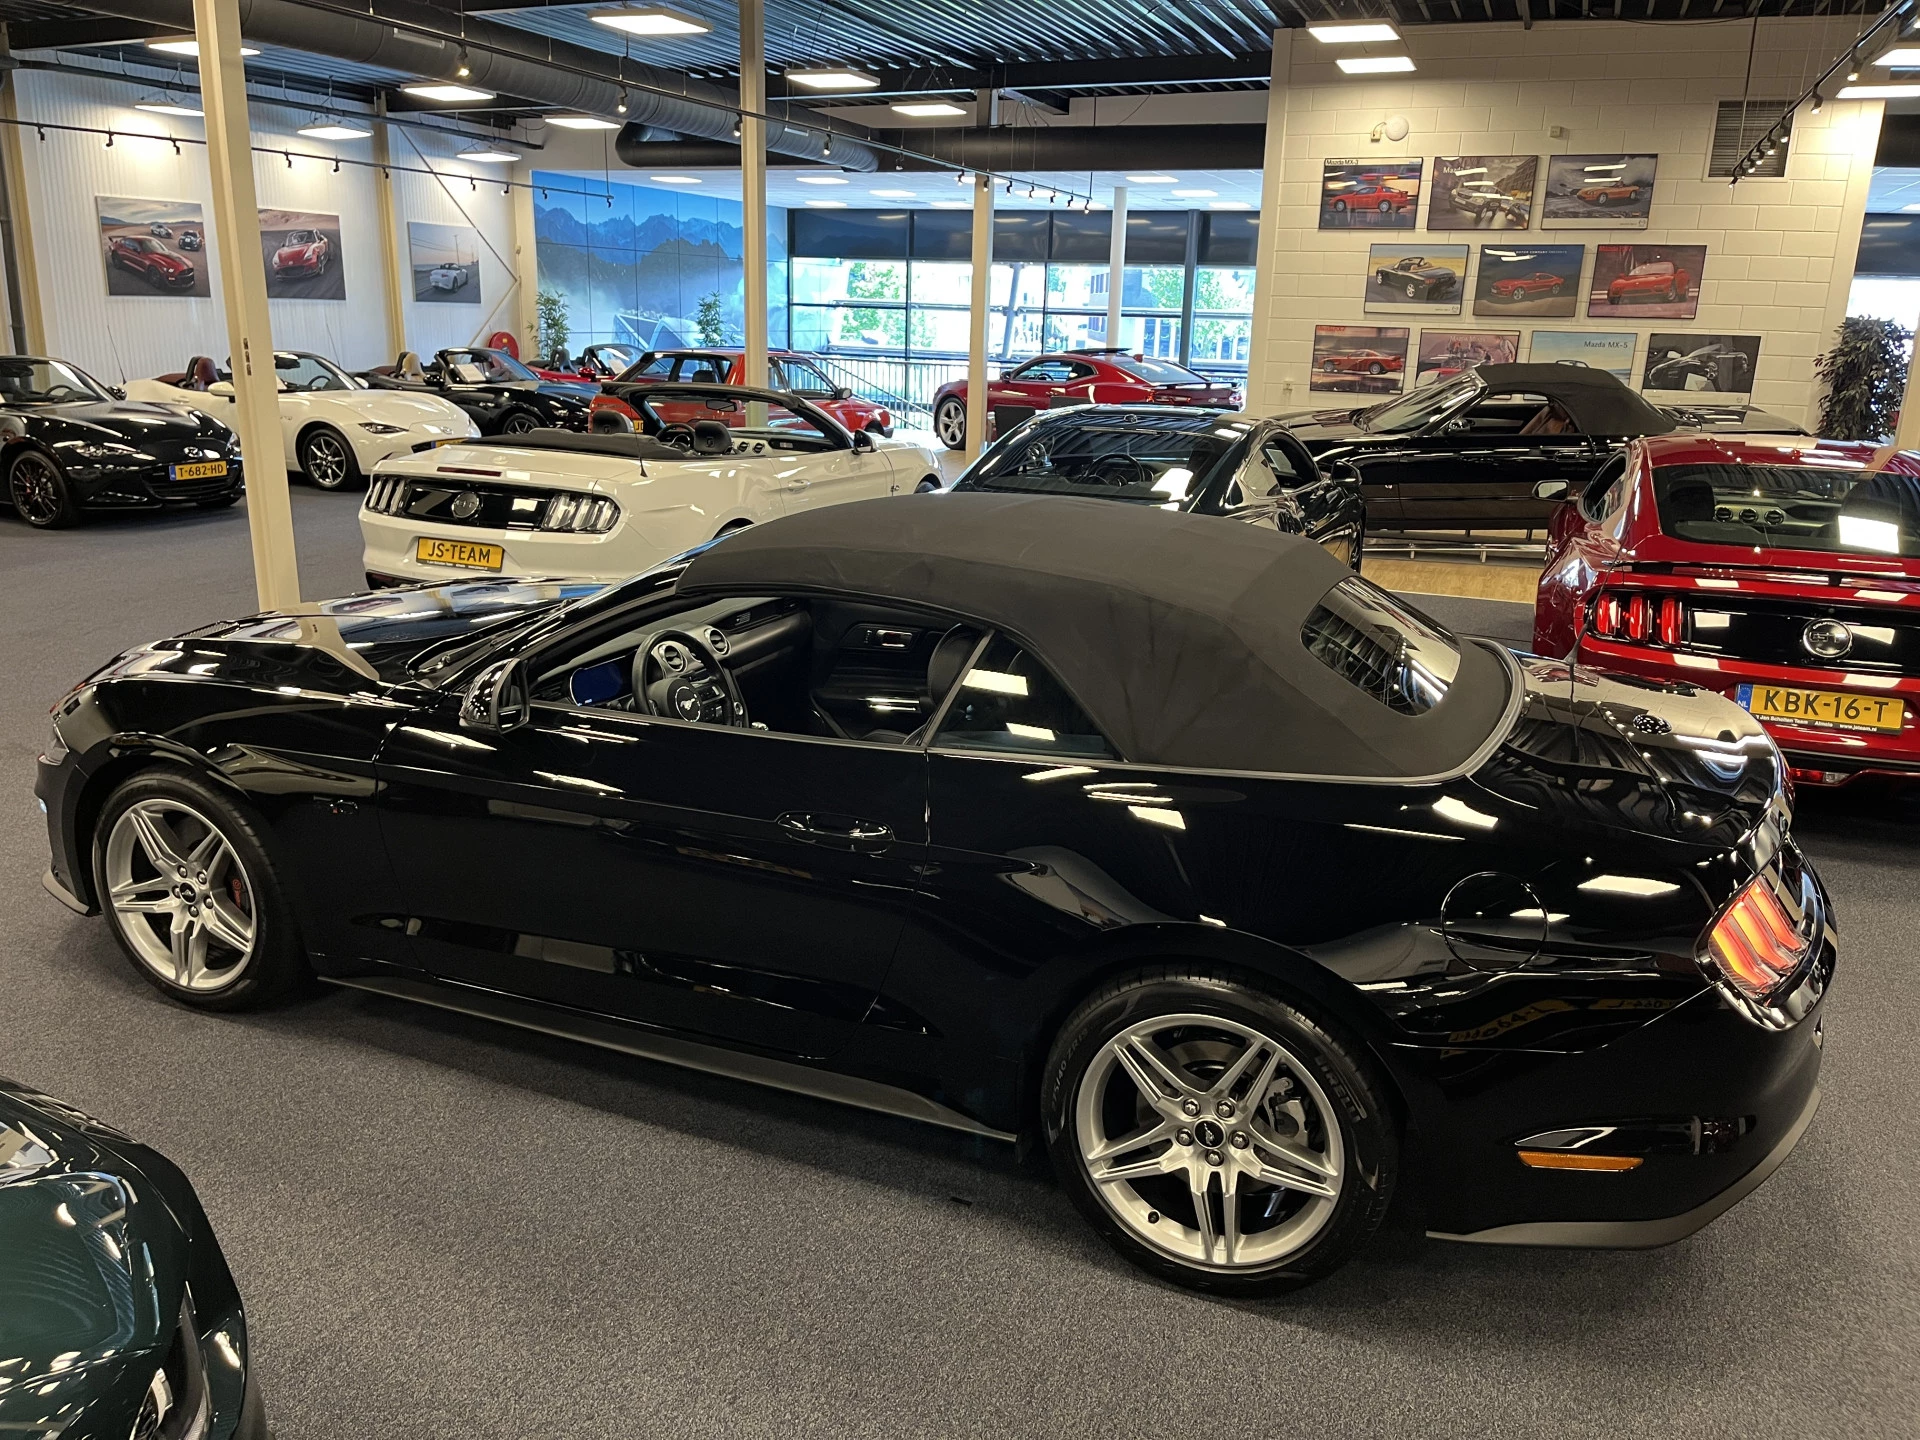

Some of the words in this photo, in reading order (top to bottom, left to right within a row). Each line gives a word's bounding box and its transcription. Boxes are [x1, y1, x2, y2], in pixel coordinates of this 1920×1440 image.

[1608, 341, 1628, 349] MX-5
[178, 464, 224, 478] T-682-HD
[428, 541, 491, 564] JS-TEAM
[1763, 689, 1889, 723] KBK-16-T
